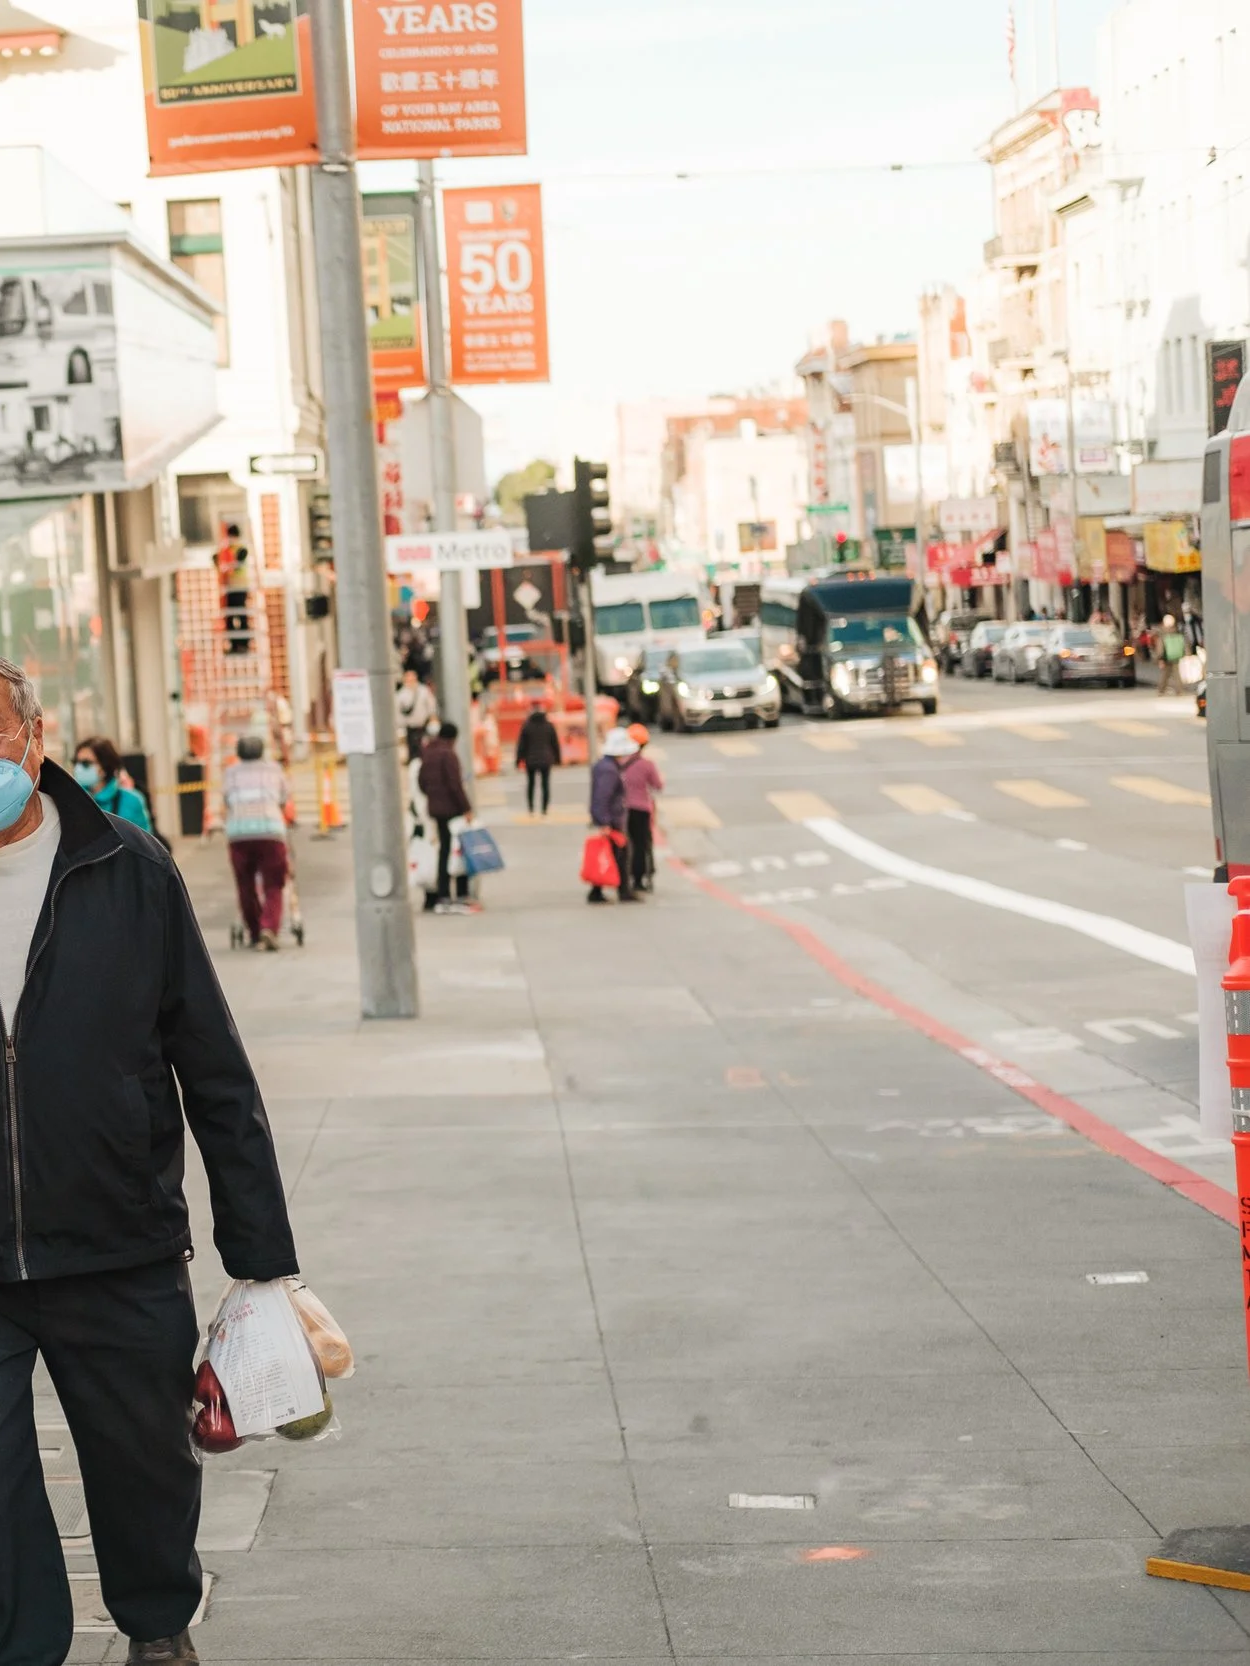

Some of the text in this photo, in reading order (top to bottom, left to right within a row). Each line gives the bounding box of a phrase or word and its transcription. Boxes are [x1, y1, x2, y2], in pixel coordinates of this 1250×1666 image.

[377, 2, 498, 35] YEARS
[402, 103, 437, 116] YOUR
[465, 100, 500, 113] AREA
[381, 116, 501, 134] NATIONAL PARKS
[459, 240, 533, 294] 50
[462, 292, 534, 315] YEARS
[437, 542, 507, 561] Metro
